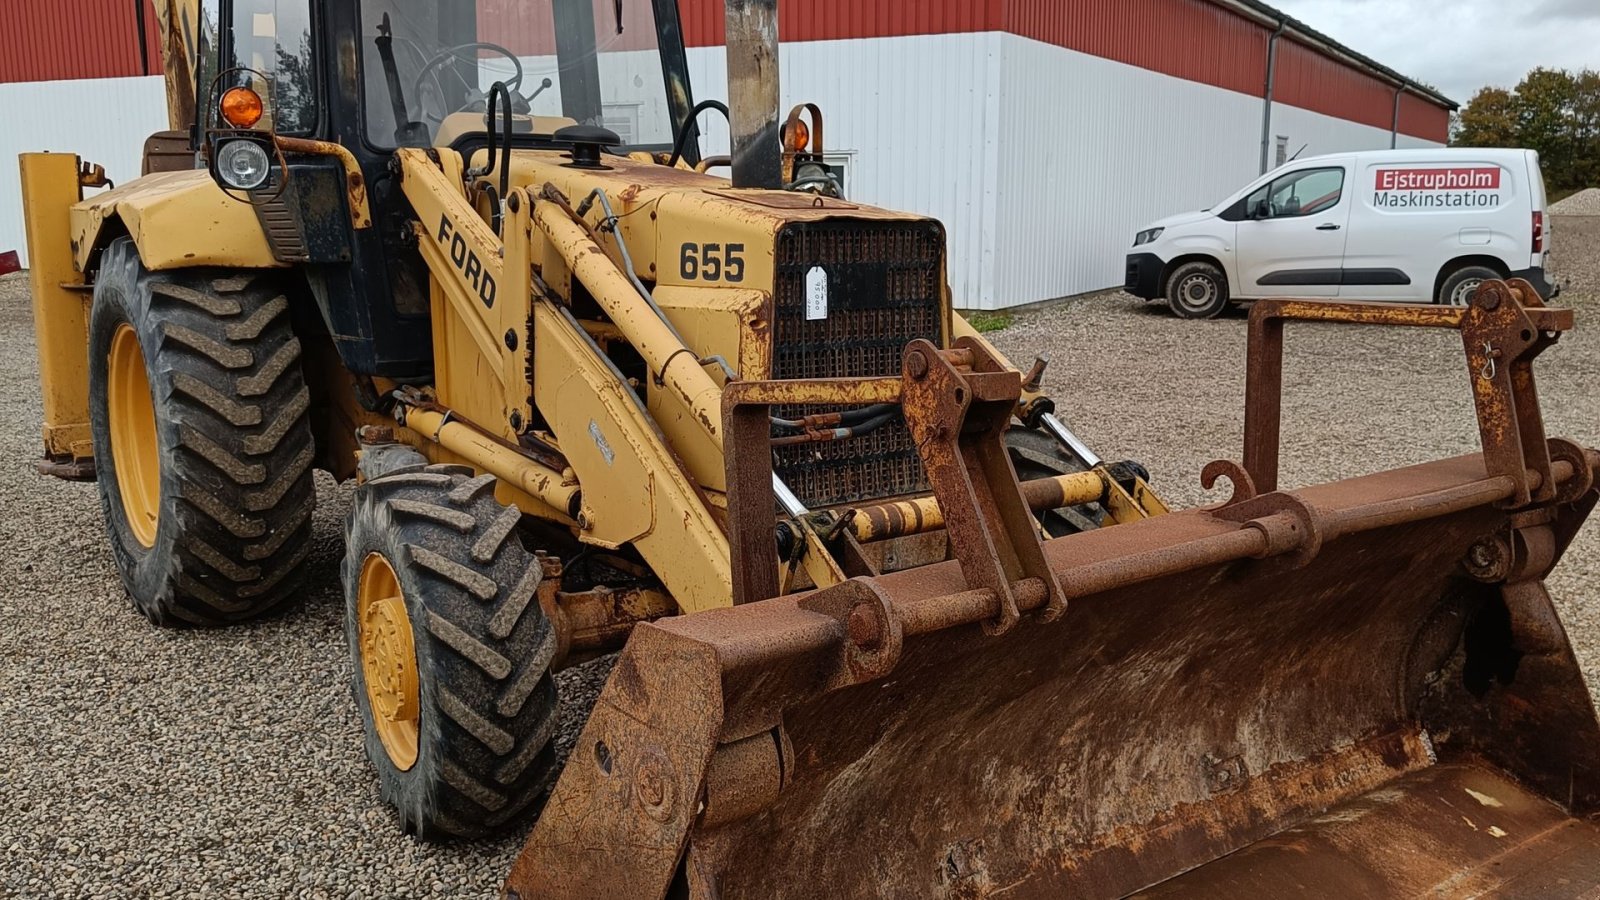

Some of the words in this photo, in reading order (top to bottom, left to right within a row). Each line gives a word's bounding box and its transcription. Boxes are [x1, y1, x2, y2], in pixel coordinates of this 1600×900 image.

[1382, 170, 1492, 190] Ejstrupholm
[1373, 190, 1500, 207] Maskinstation
[437, 212, 497, 309] FORD
[680, 242, 745, 282] 655
